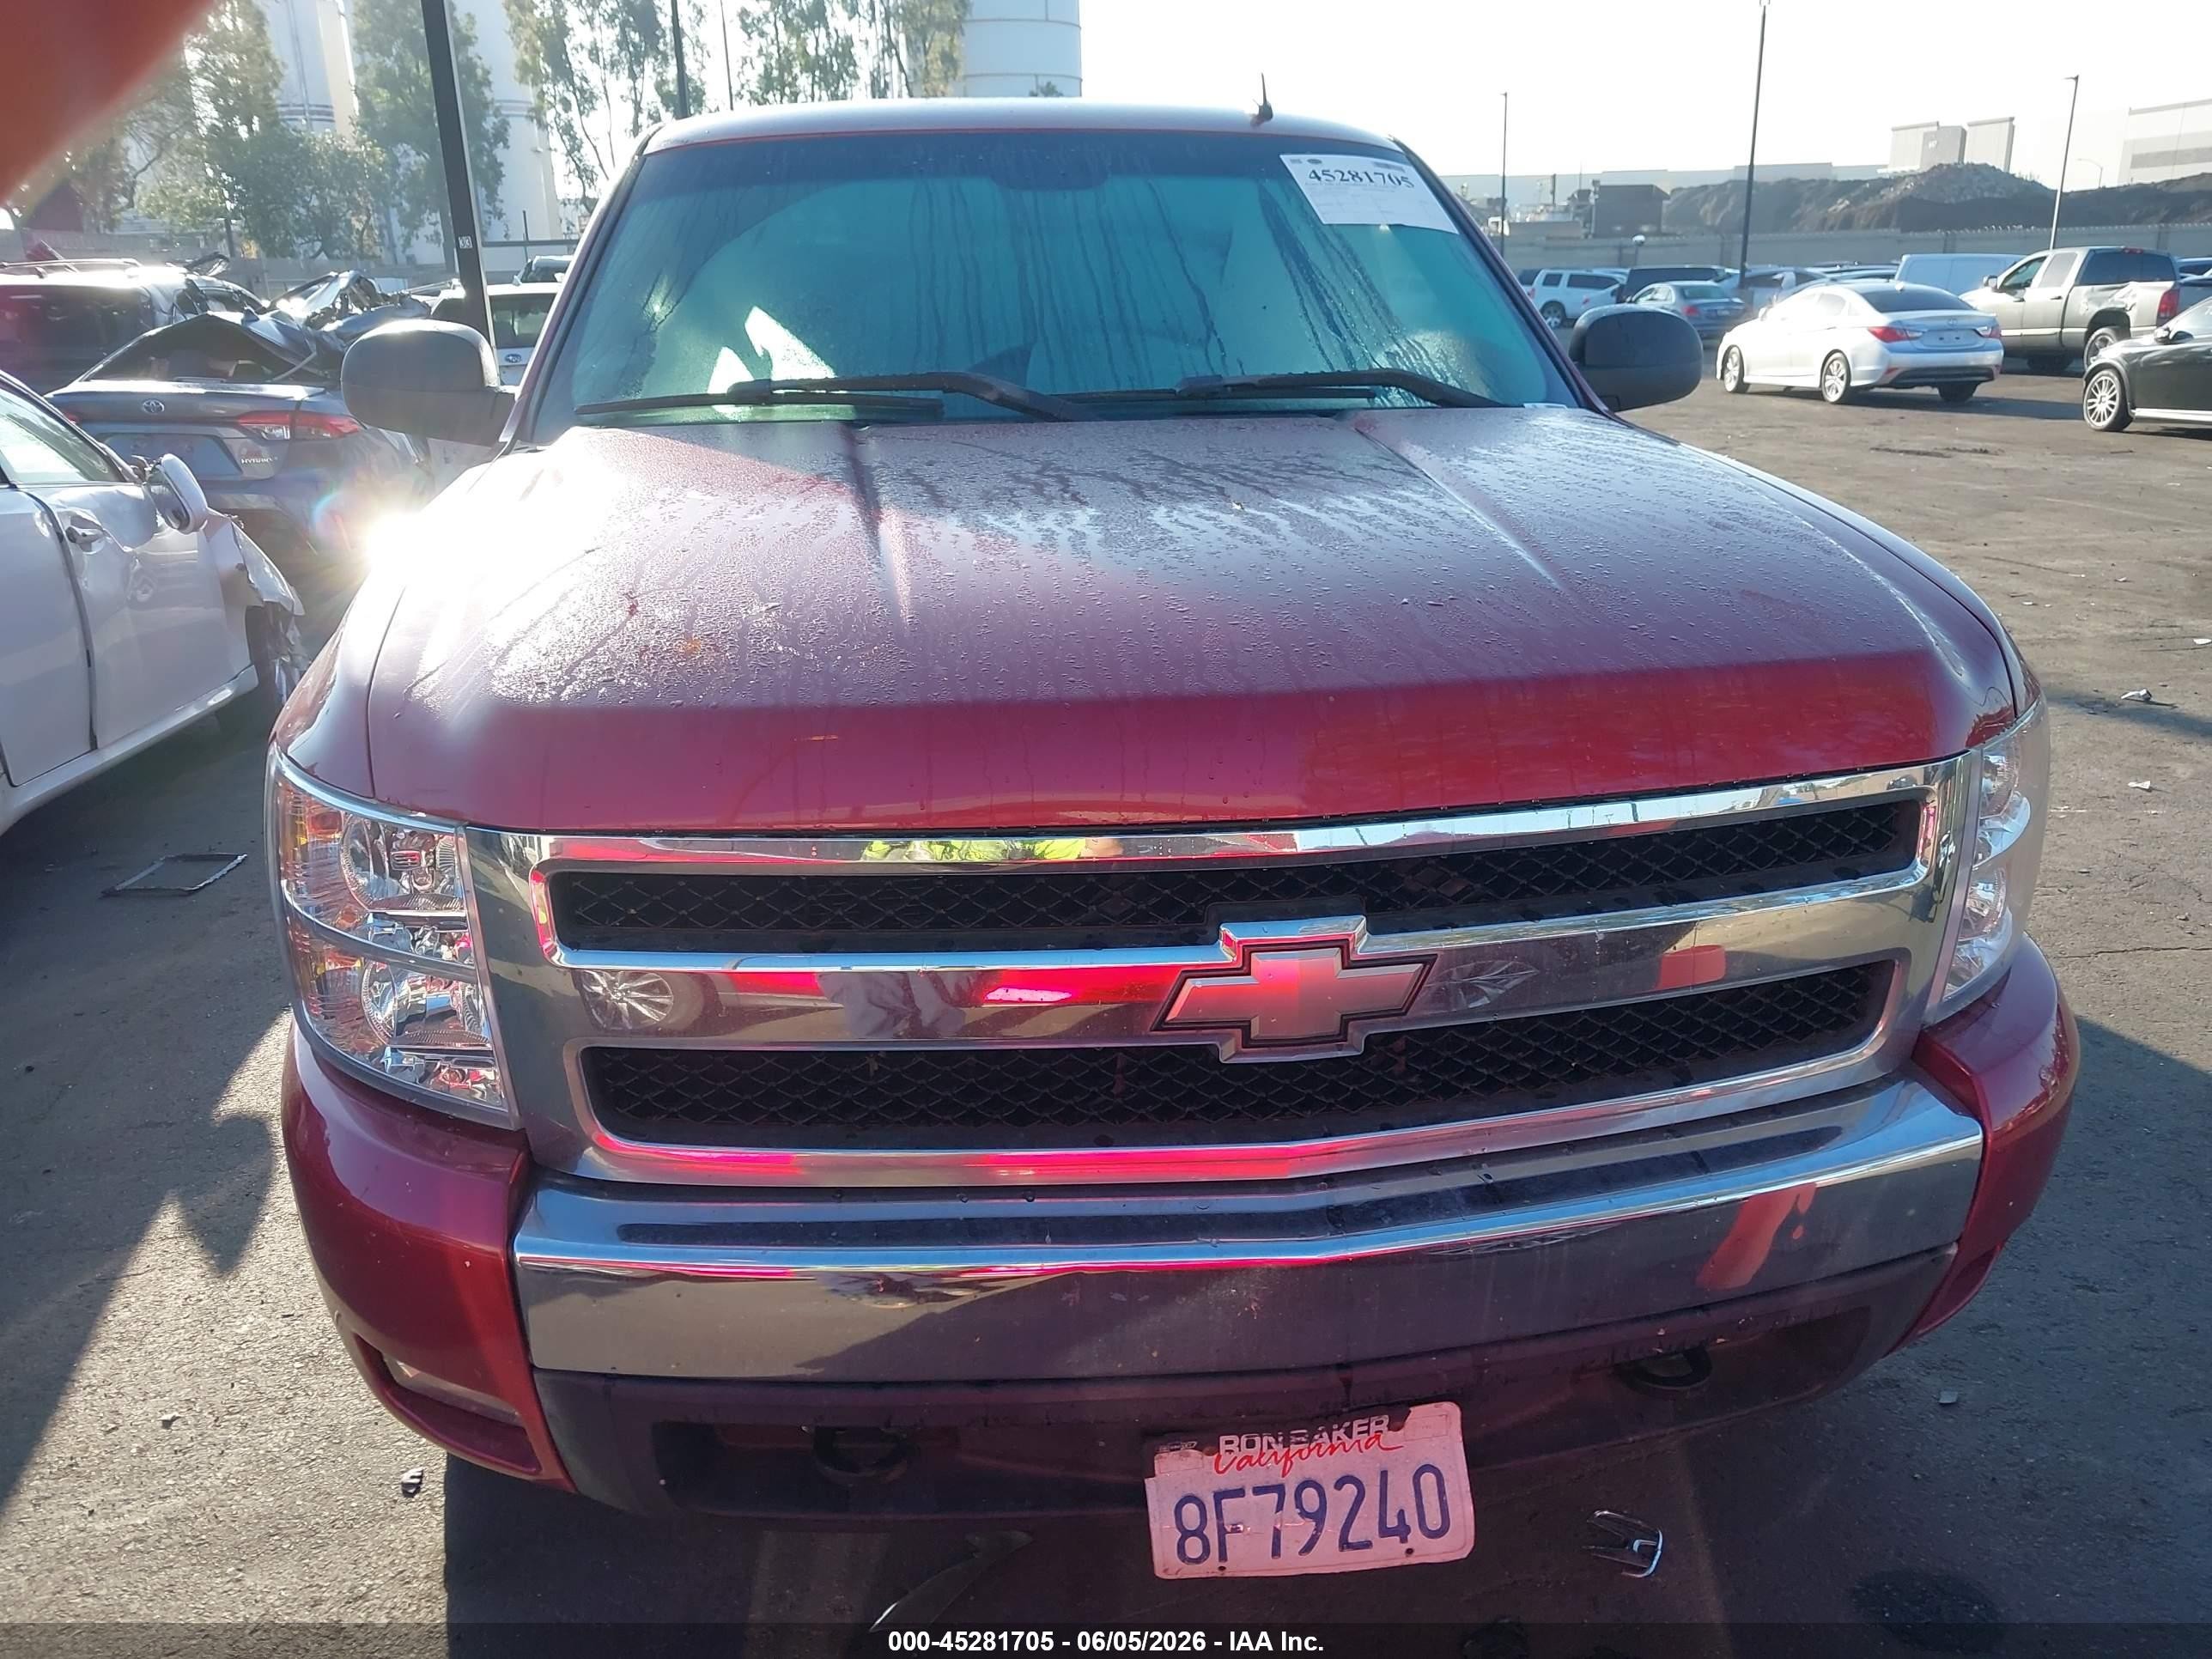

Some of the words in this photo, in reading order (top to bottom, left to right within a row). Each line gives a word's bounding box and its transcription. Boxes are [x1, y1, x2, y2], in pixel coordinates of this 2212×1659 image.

[1308, 168, 1414, 188] 45281705
[1218, 1433, 1284, 1455] RON
[1290, 1415, 1389, 1445] BAKER
[1174, 1464, 1450, 1565] 8F79240
